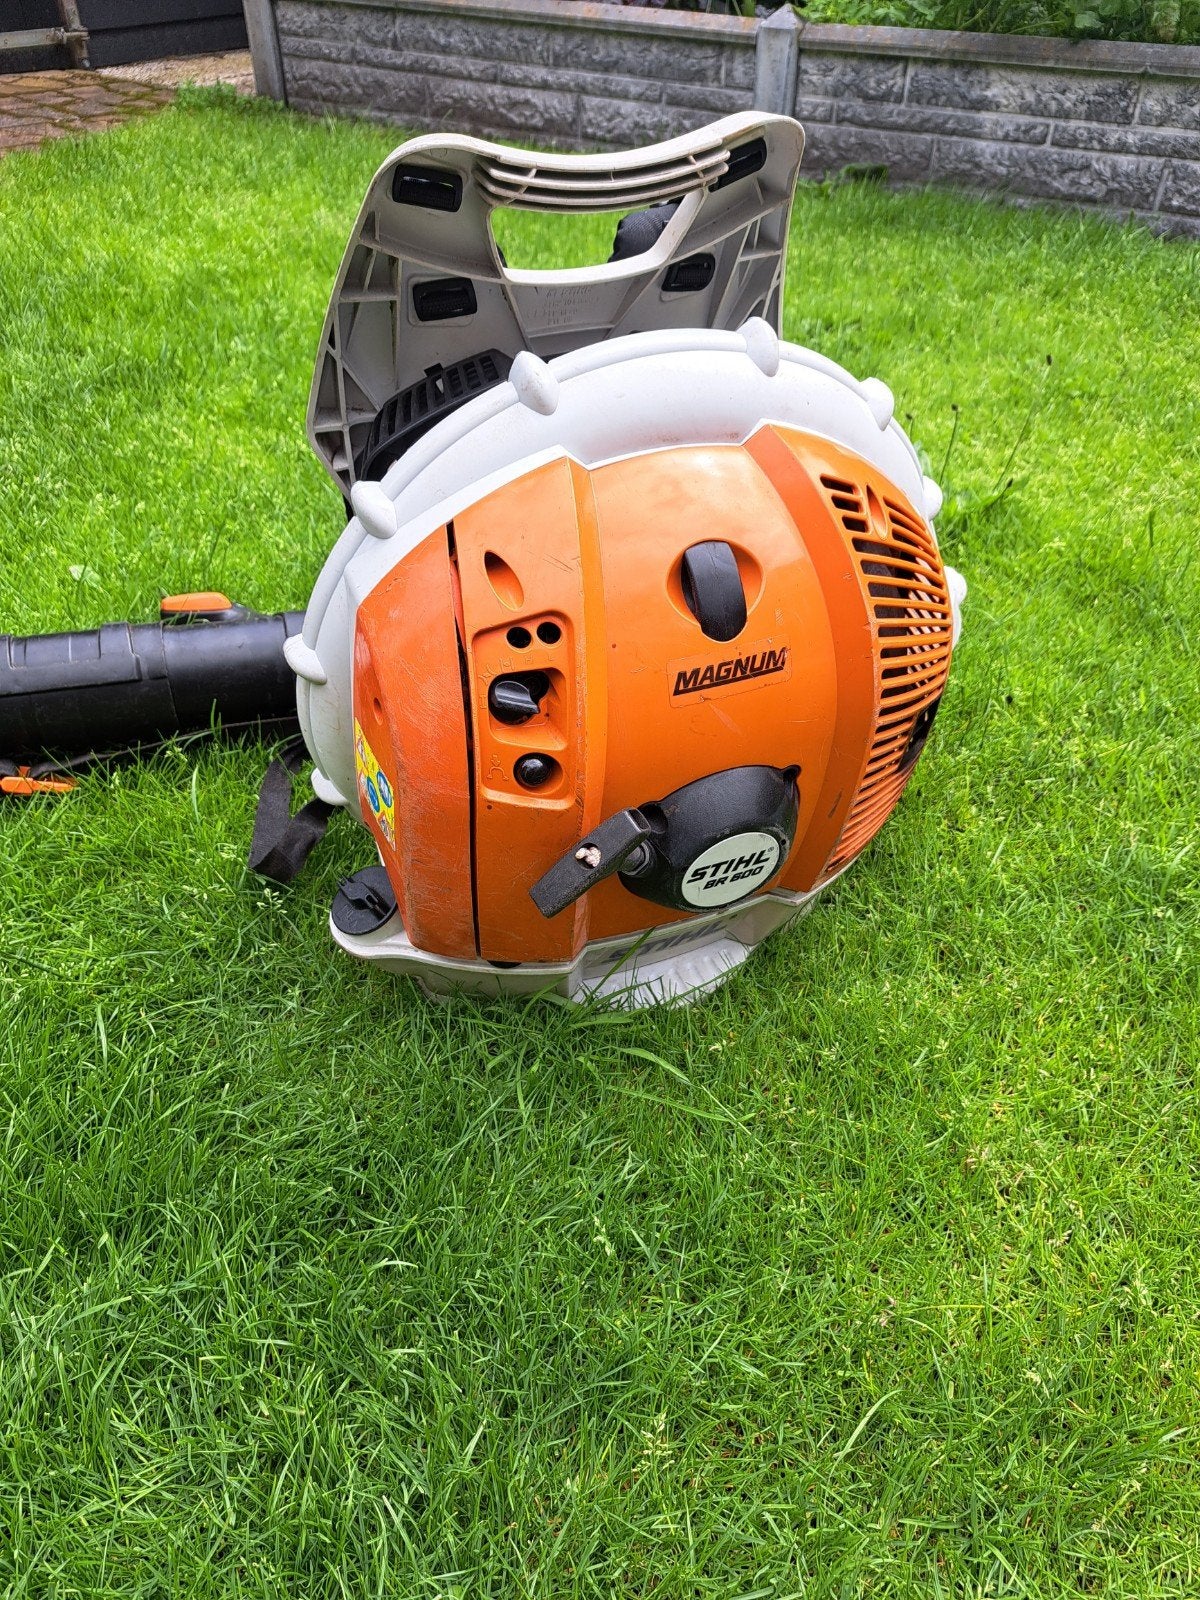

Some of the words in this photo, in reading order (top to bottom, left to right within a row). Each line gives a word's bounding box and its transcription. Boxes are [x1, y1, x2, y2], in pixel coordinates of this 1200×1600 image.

[673, 647, 787, 695] MAGNUM
[703, 876, 729, 890] BR
[729, 865, 764, 883] 600
